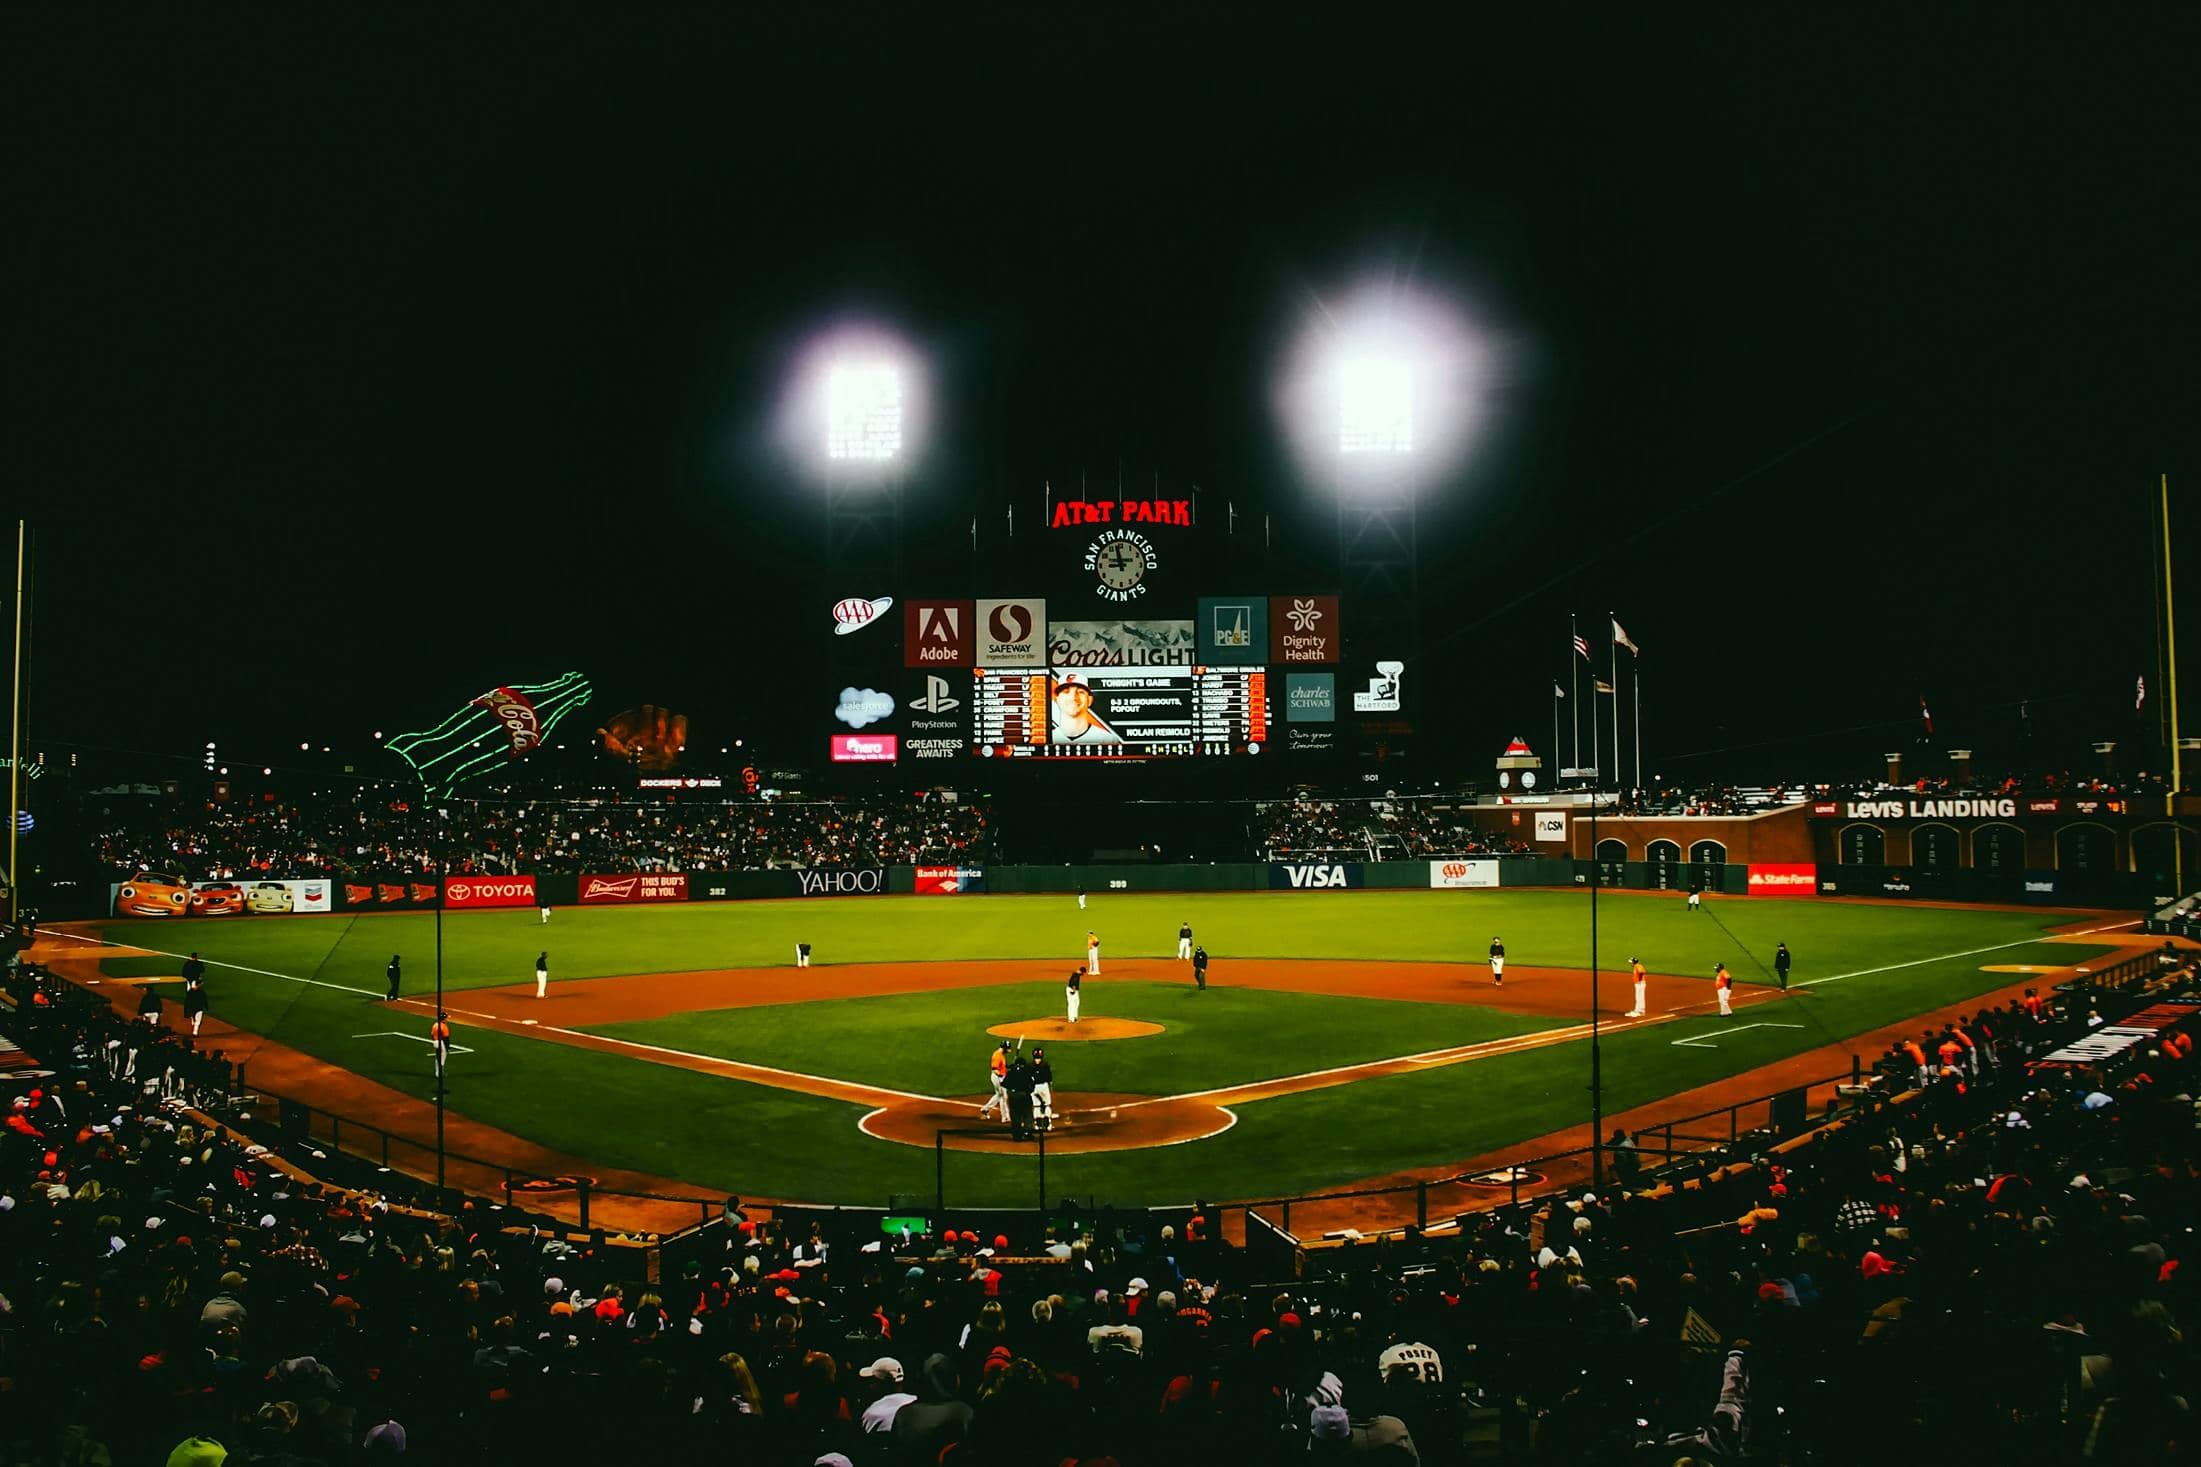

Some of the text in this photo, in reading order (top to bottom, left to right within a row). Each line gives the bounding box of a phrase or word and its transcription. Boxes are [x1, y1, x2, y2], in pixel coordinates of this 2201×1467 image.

[1052, 499, 1190, 528] AT&T PARK
[1084, 529, 1157, 571] SAN FRANCISCO
[1096, 583, 1146, 602] GIANTS
[1216, 630, 1249, 645] PG&E
[1283, 635, 1326, 649] Dignity
[919, 647, 958, 660] Adobe
[989, 644, 1032, 653] SAFEWAY
[1048, 639, 1195, 666] Coors LIGHT
[1286, 649, 1325, 661] Health
[1101, 679, 1170, 687] TONIGHT'S GAME
[1290, 686, 1330, 698] charles
[843, 701, 889, 713] salesforce
[1130, 698, 1182, 706] GROUNDOUTS,
[1290, 700, 1331, 708] SCHWAB
[911, 720, 958, 731] PlayStation
[1127, 729, 1154, 737] NOLAN
[906, 739, 964, 749] GREATNESS
[1910, 799, 2016, 817] LANDING
[1547, 820, 1564, 831] CSN
[917, 868, 982, 878] Bank of America
[1282, 865, 1346, 887] VISA
[641, 876, 685, 886] THIS BUD'S
[797, 869, 884, 896] YAHOO!
[473, 884, 535, 898] TOYOTA
[641, 887, 676, 897] FOR YOU.
[1398, 1349, 1433, 1361] POSEY
